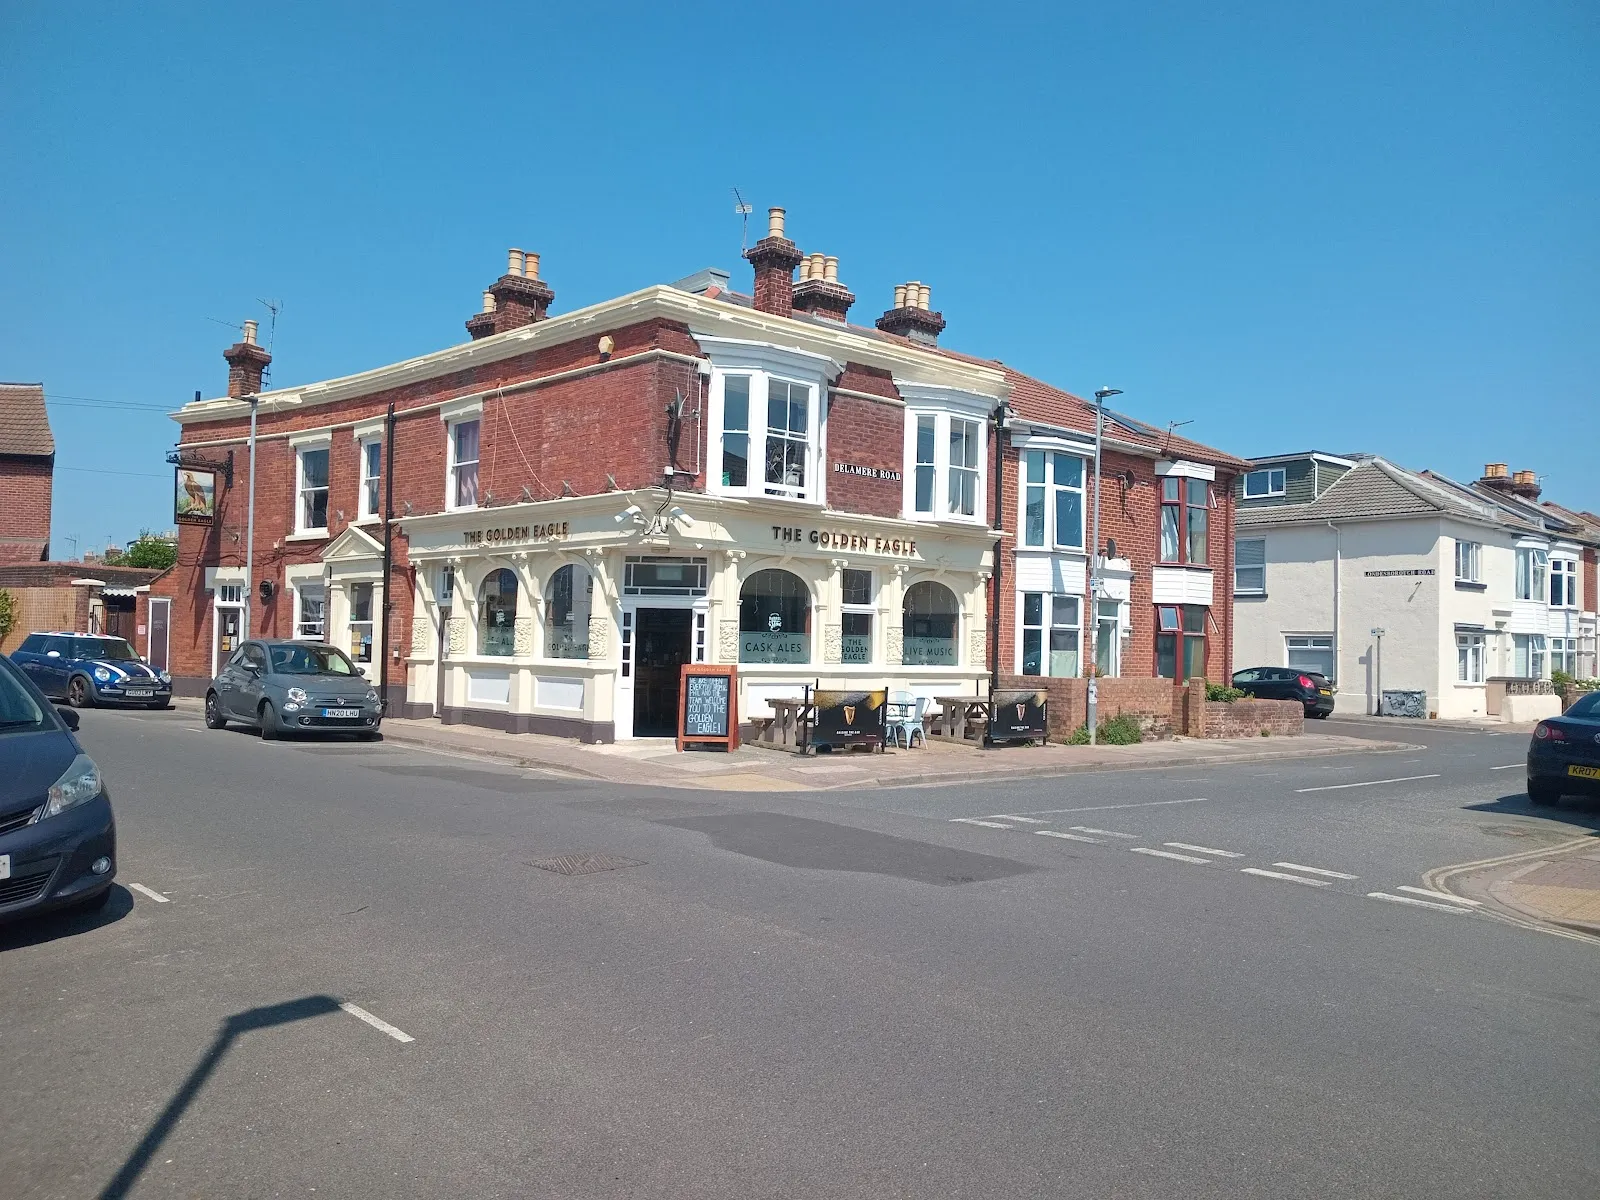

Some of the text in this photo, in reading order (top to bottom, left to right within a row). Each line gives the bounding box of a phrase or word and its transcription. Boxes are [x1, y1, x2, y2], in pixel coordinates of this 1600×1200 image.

[834, 463, 901, 481] DELAMERE ROAD
[463, 521, 569, 543] THE GOLDEN EAGLE
[772, 526, 916, 553] THE GOLDEN EAGLE
[745, 642, 802, 653] CASK ALES
[904, 648, 953, 656] LIVE MUSIC
[844, 652, 866, 660] EAGLE
[689, 696, 727, 705] TEAM WELCOME
[688, 703, 726, 714] YOU TO THE
[688, 713, 714, 723] GOLDEN
[697, 722, 721, 734] EAGLE!
[1572, 766, 1598, 777] KR07
